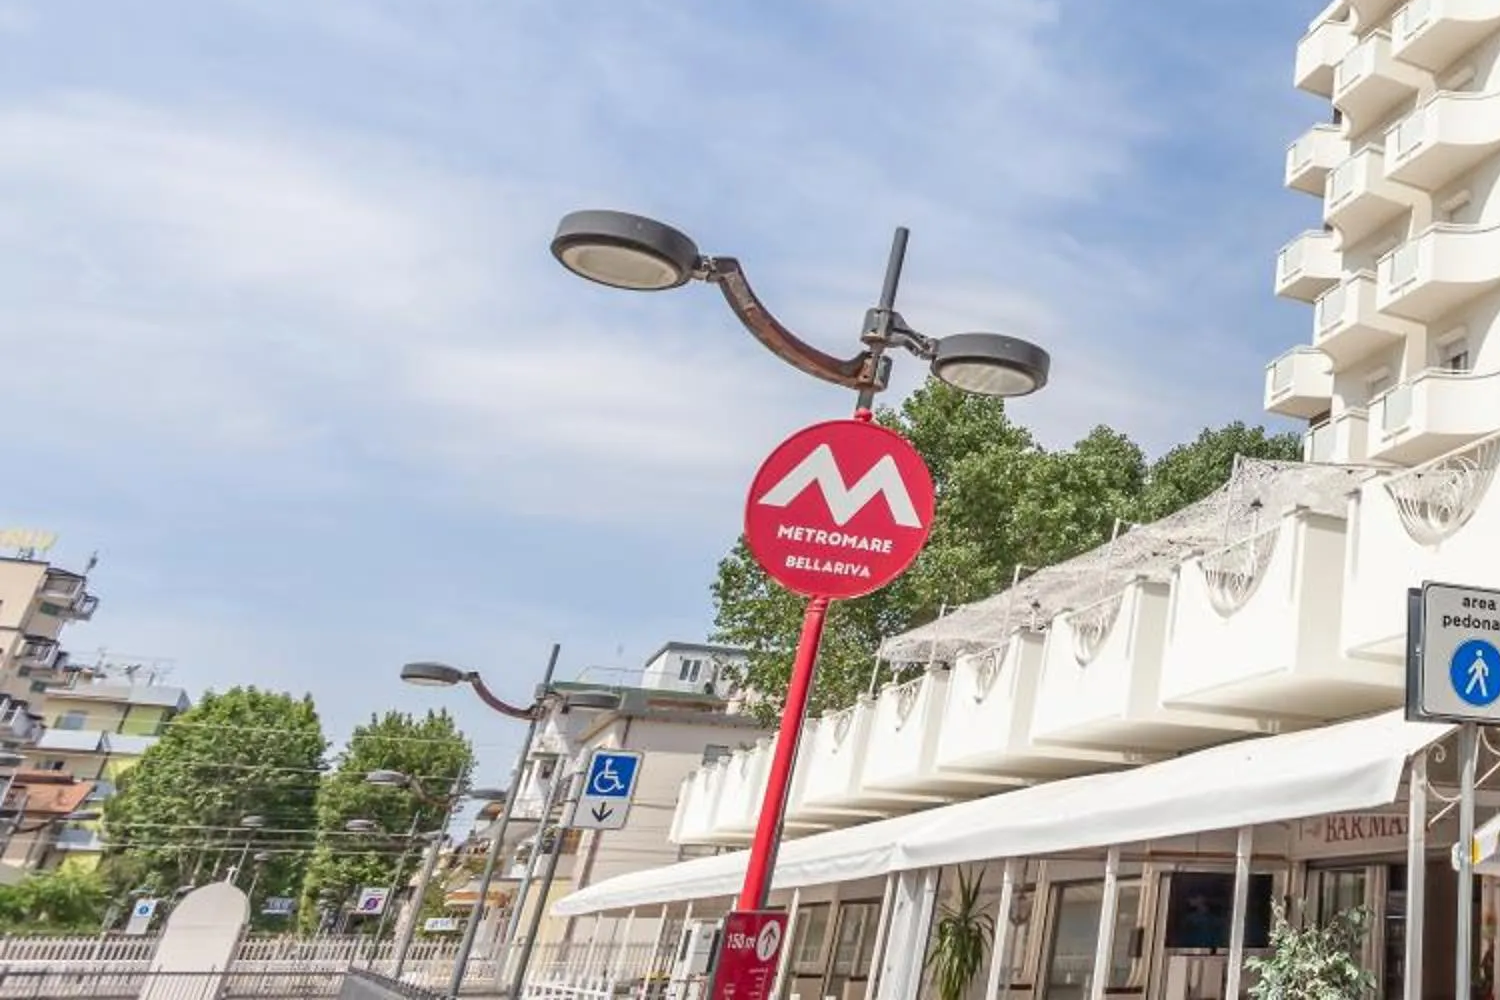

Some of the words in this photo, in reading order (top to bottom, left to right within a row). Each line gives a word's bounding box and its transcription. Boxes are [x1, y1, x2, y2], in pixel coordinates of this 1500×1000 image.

[777, 524, 893, 553] METROMARE
[785, 555, 871, 578] BELLARIVA
[1462, 597, 1496, 611] area
